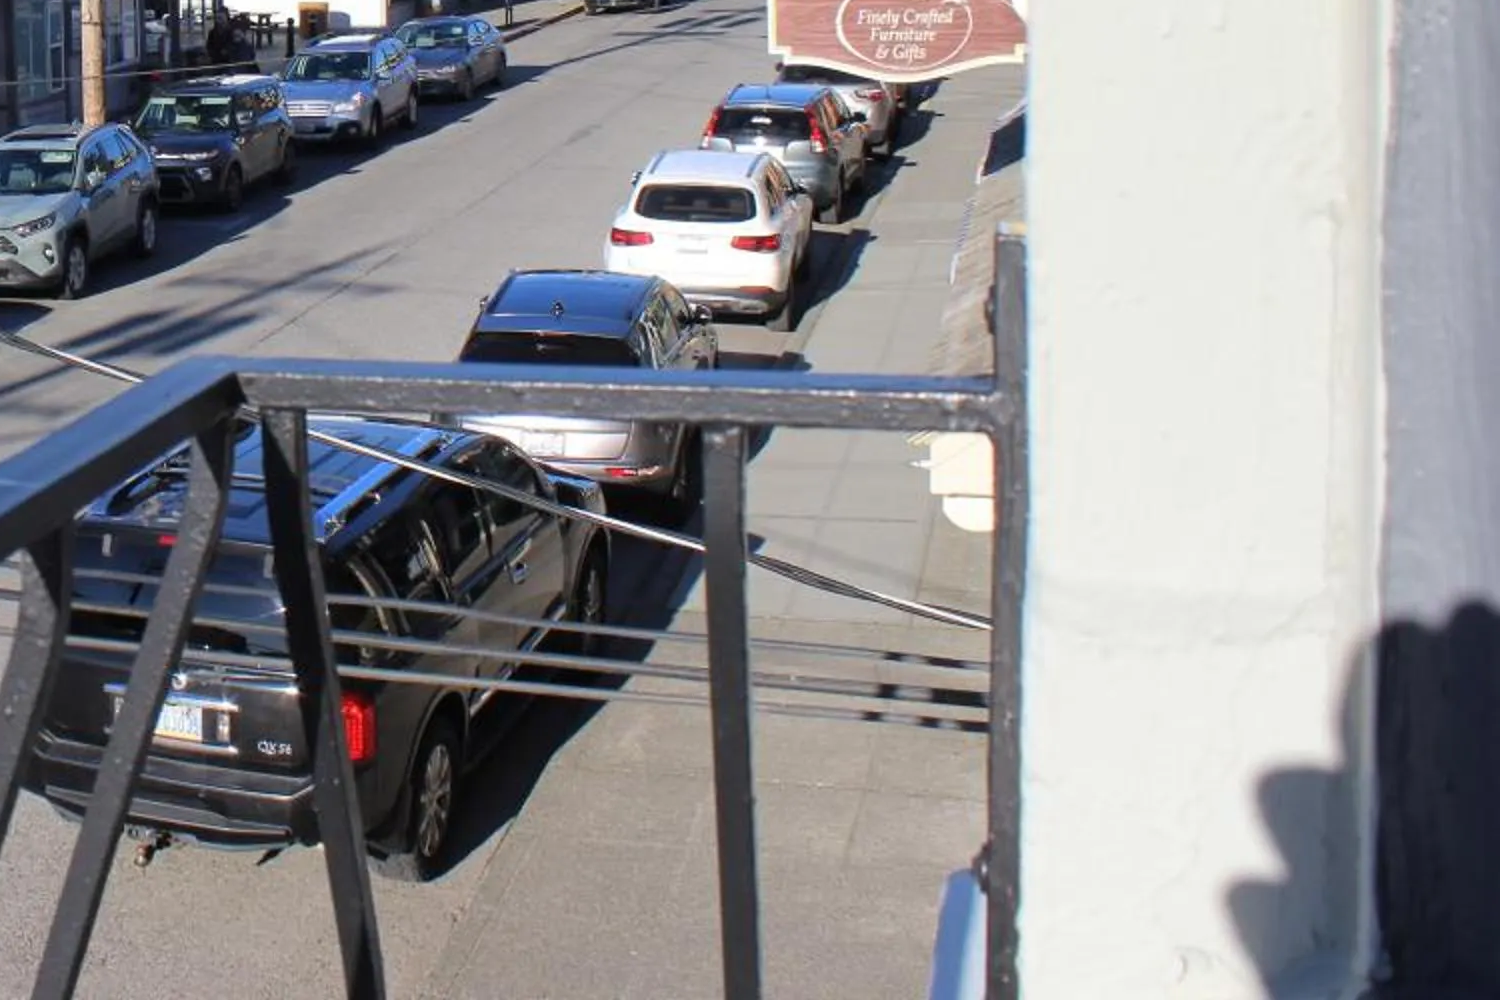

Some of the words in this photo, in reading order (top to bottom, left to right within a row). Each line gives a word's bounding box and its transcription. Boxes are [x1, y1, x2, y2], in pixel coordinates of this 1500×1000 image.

[857, 8, 900, 29] Finely
[903, 7, 954, 29] Crafted
[869, 27, 938, 41] Furniture
[875, 43, 889, 59] &
[892, 43, 927, 66] Gifts
